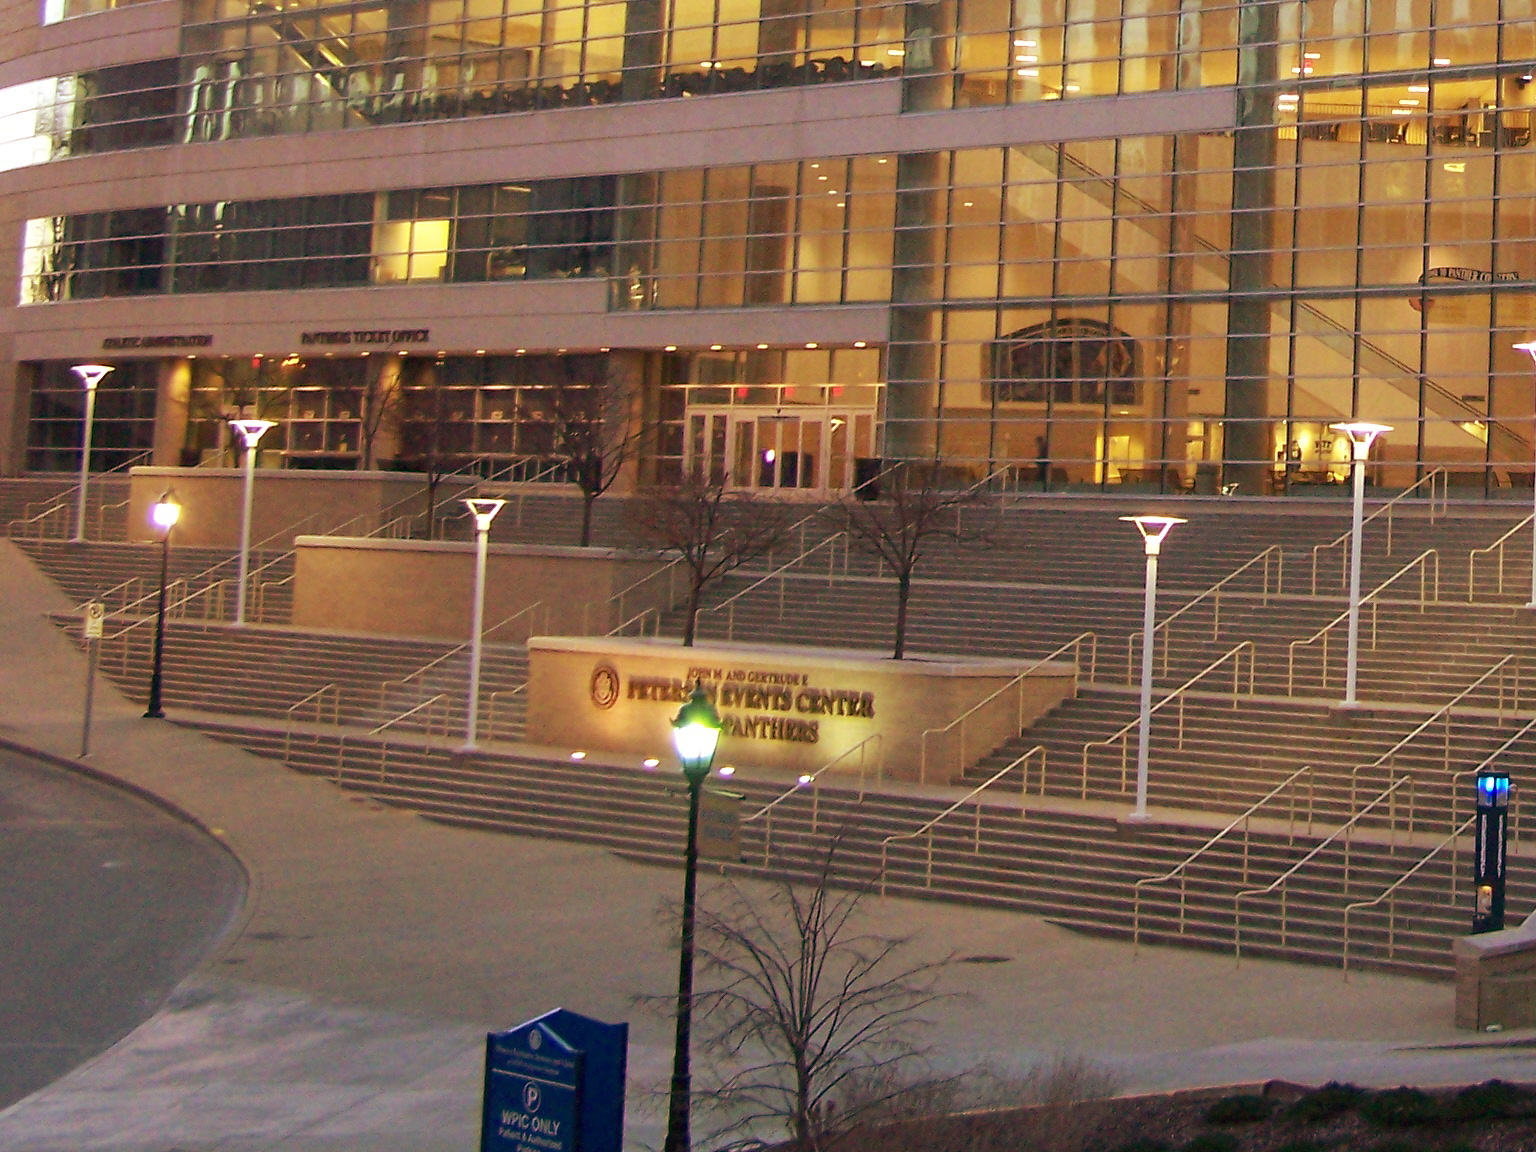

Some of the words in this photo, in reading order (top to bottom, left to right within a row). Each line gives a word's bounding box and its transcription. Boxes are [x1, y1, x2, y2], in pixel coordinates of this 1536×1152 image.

[726, 669, 746, 682] AND
[748, 671, 800, 685] GERTRUDE
[720, 682, 793, 711] EVENTS
[795, 686, 876, 719] CENTER
[722, 714, 819, 744] PANTHERS
[502, 1109, 530, 1129] WPIC
[531, 1116, 561, 1136] ONLY
